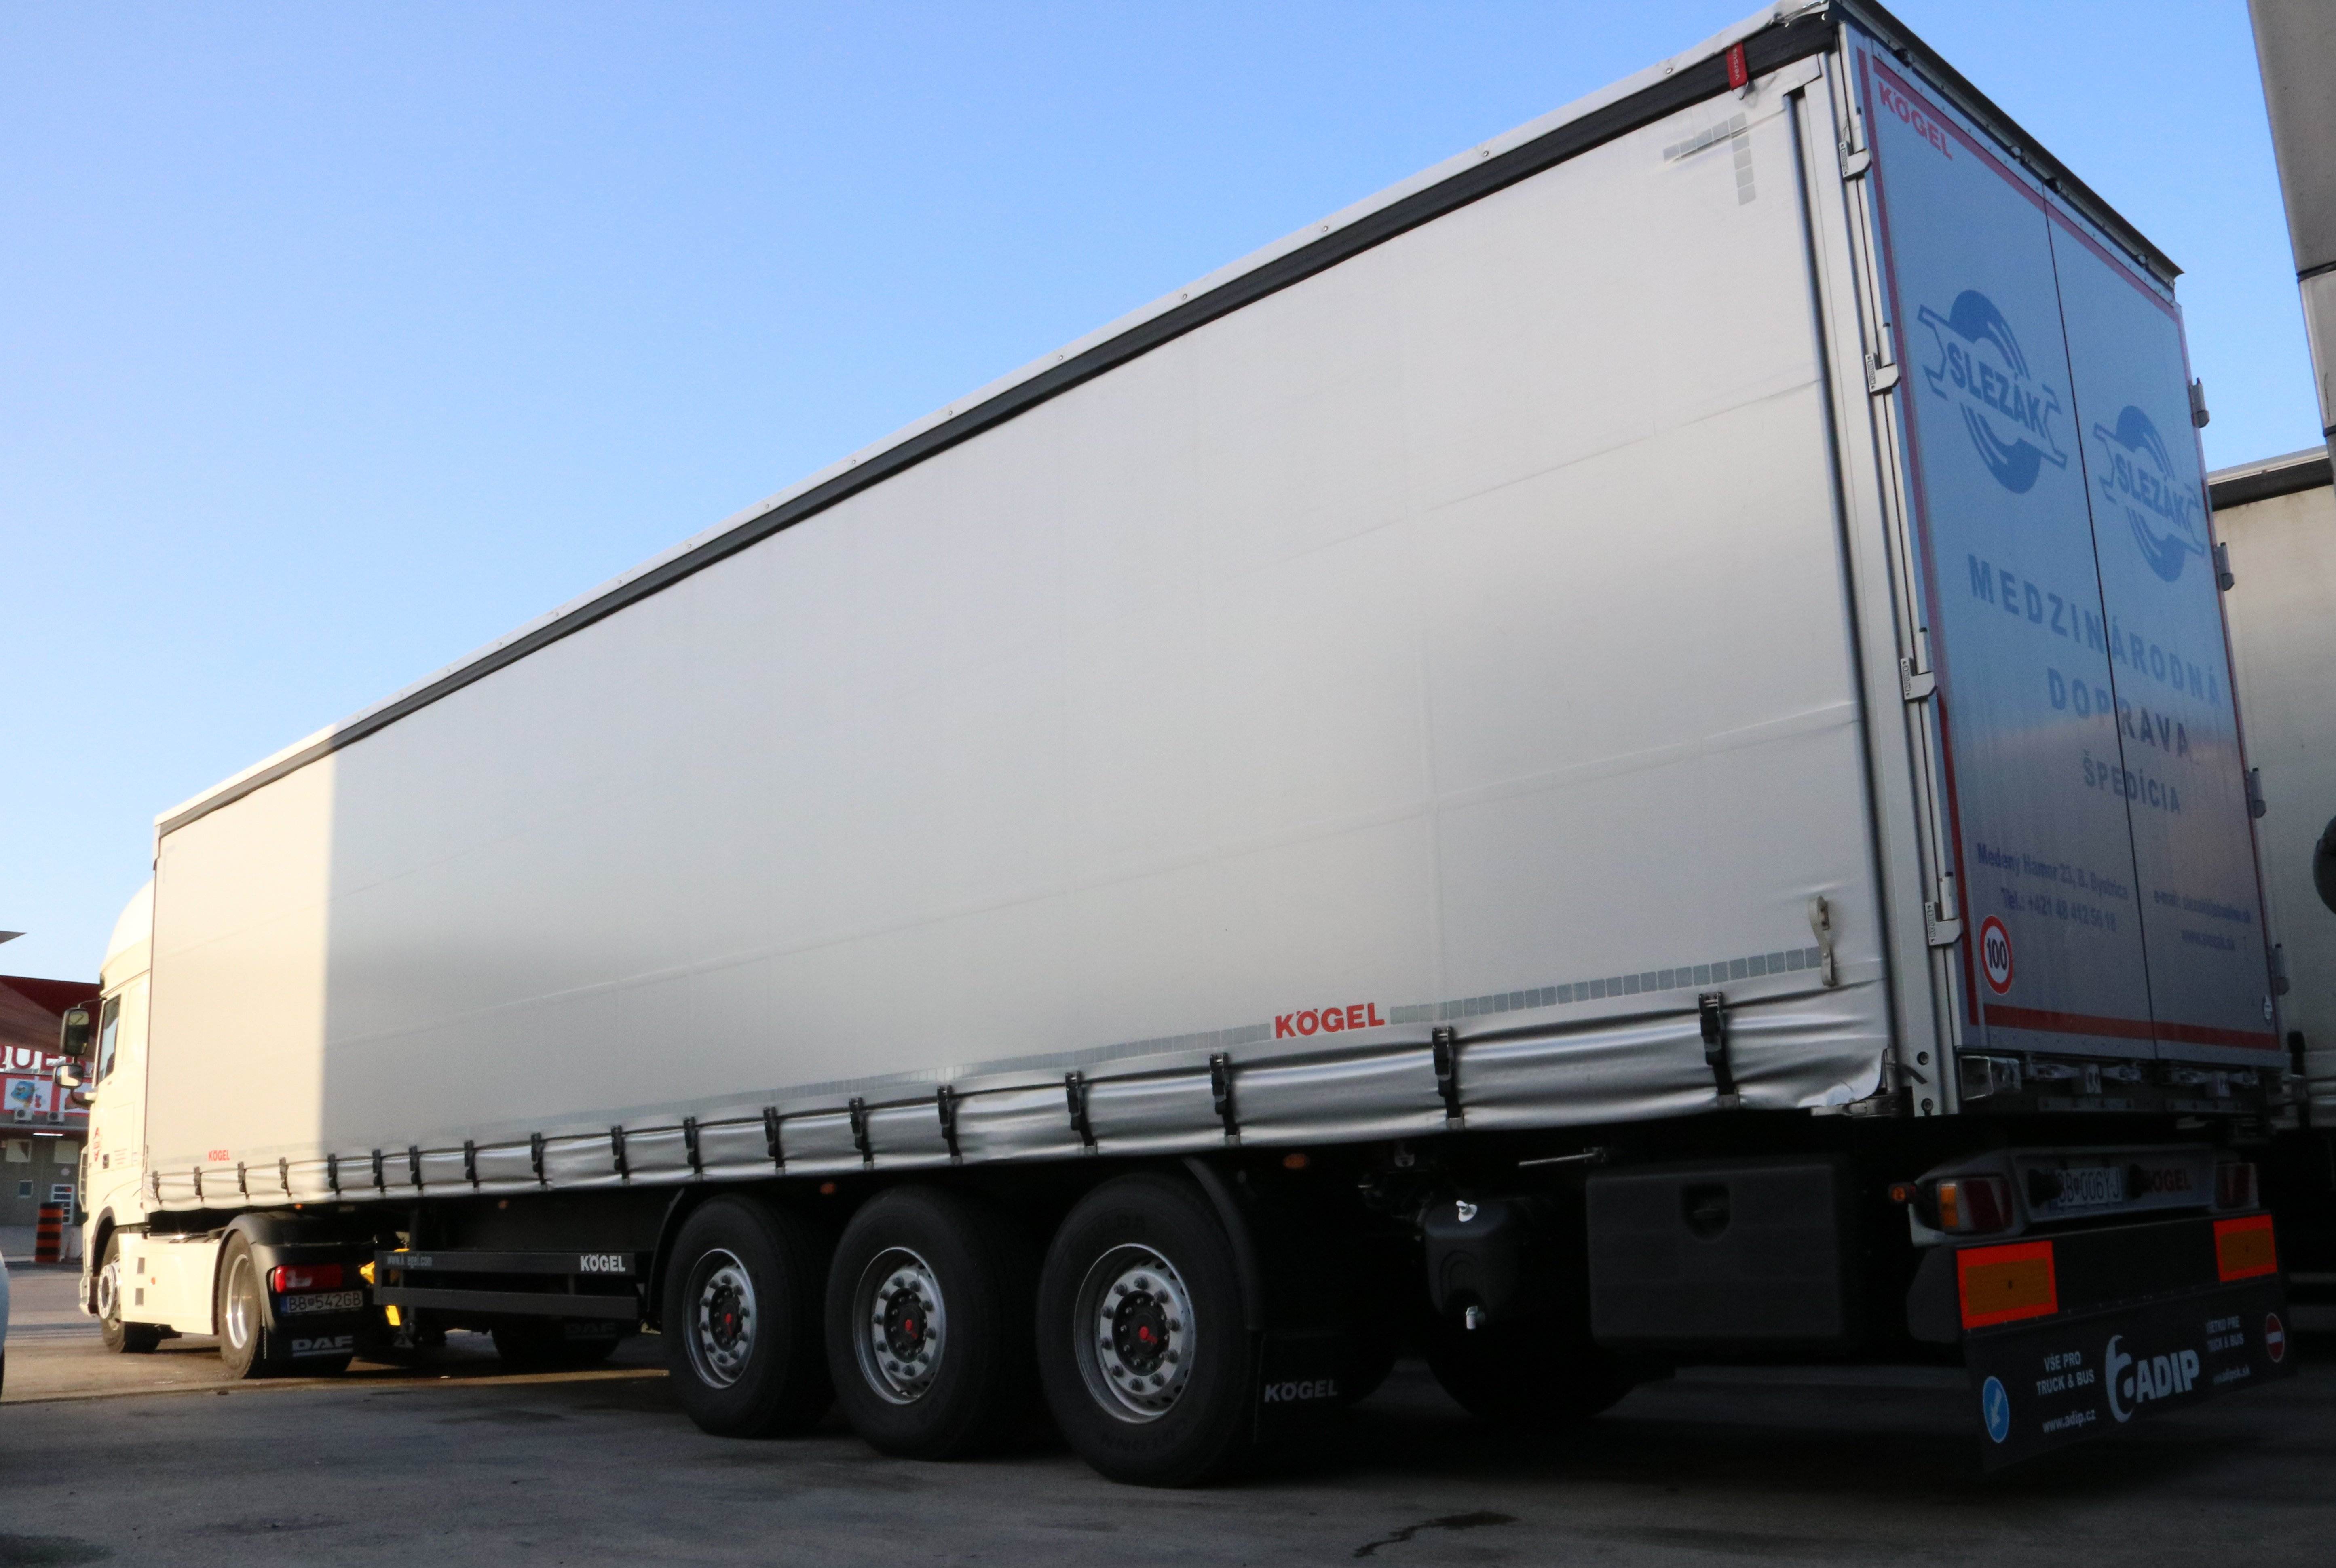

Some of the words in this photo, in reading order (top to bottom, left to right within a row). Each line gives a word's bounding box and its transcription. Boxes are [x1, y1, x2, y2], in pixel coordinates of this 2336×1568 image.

[1878, 81, 1953, 160] KÖGEL
[1947, 341, 2047, 438] SLEZÁK
[2115, 452, 2189, 532] SLEZÁK
[1968, 553, 2221, 708] MEDZINÁRODNÁ
[2047, 667, 2189, 757] DOPRAVA
[2082, 749, 2181, 815] ŠPEDÍCIA
[1986, 937, 2008, 970] 100
[1275, 1002, 1386, 1039] KÖGEL
[208, 1149, 230, 1161] KÖGEL
[580, 1254, 626, 1272] KÖGEL
[292, 1336, 353, 1350] DAF
[2063, 1351, 2082, 1368] PRO
[1263, 1378, 1339, 1403] KÖGEL
[2036, 1374, 2066, 1396] TRUCK
[2067, 1373, 2075, 1389] &
[2076, 1368, 2095, 1387] BUS
[2136, 1349, 2200, 1404] ADIP
